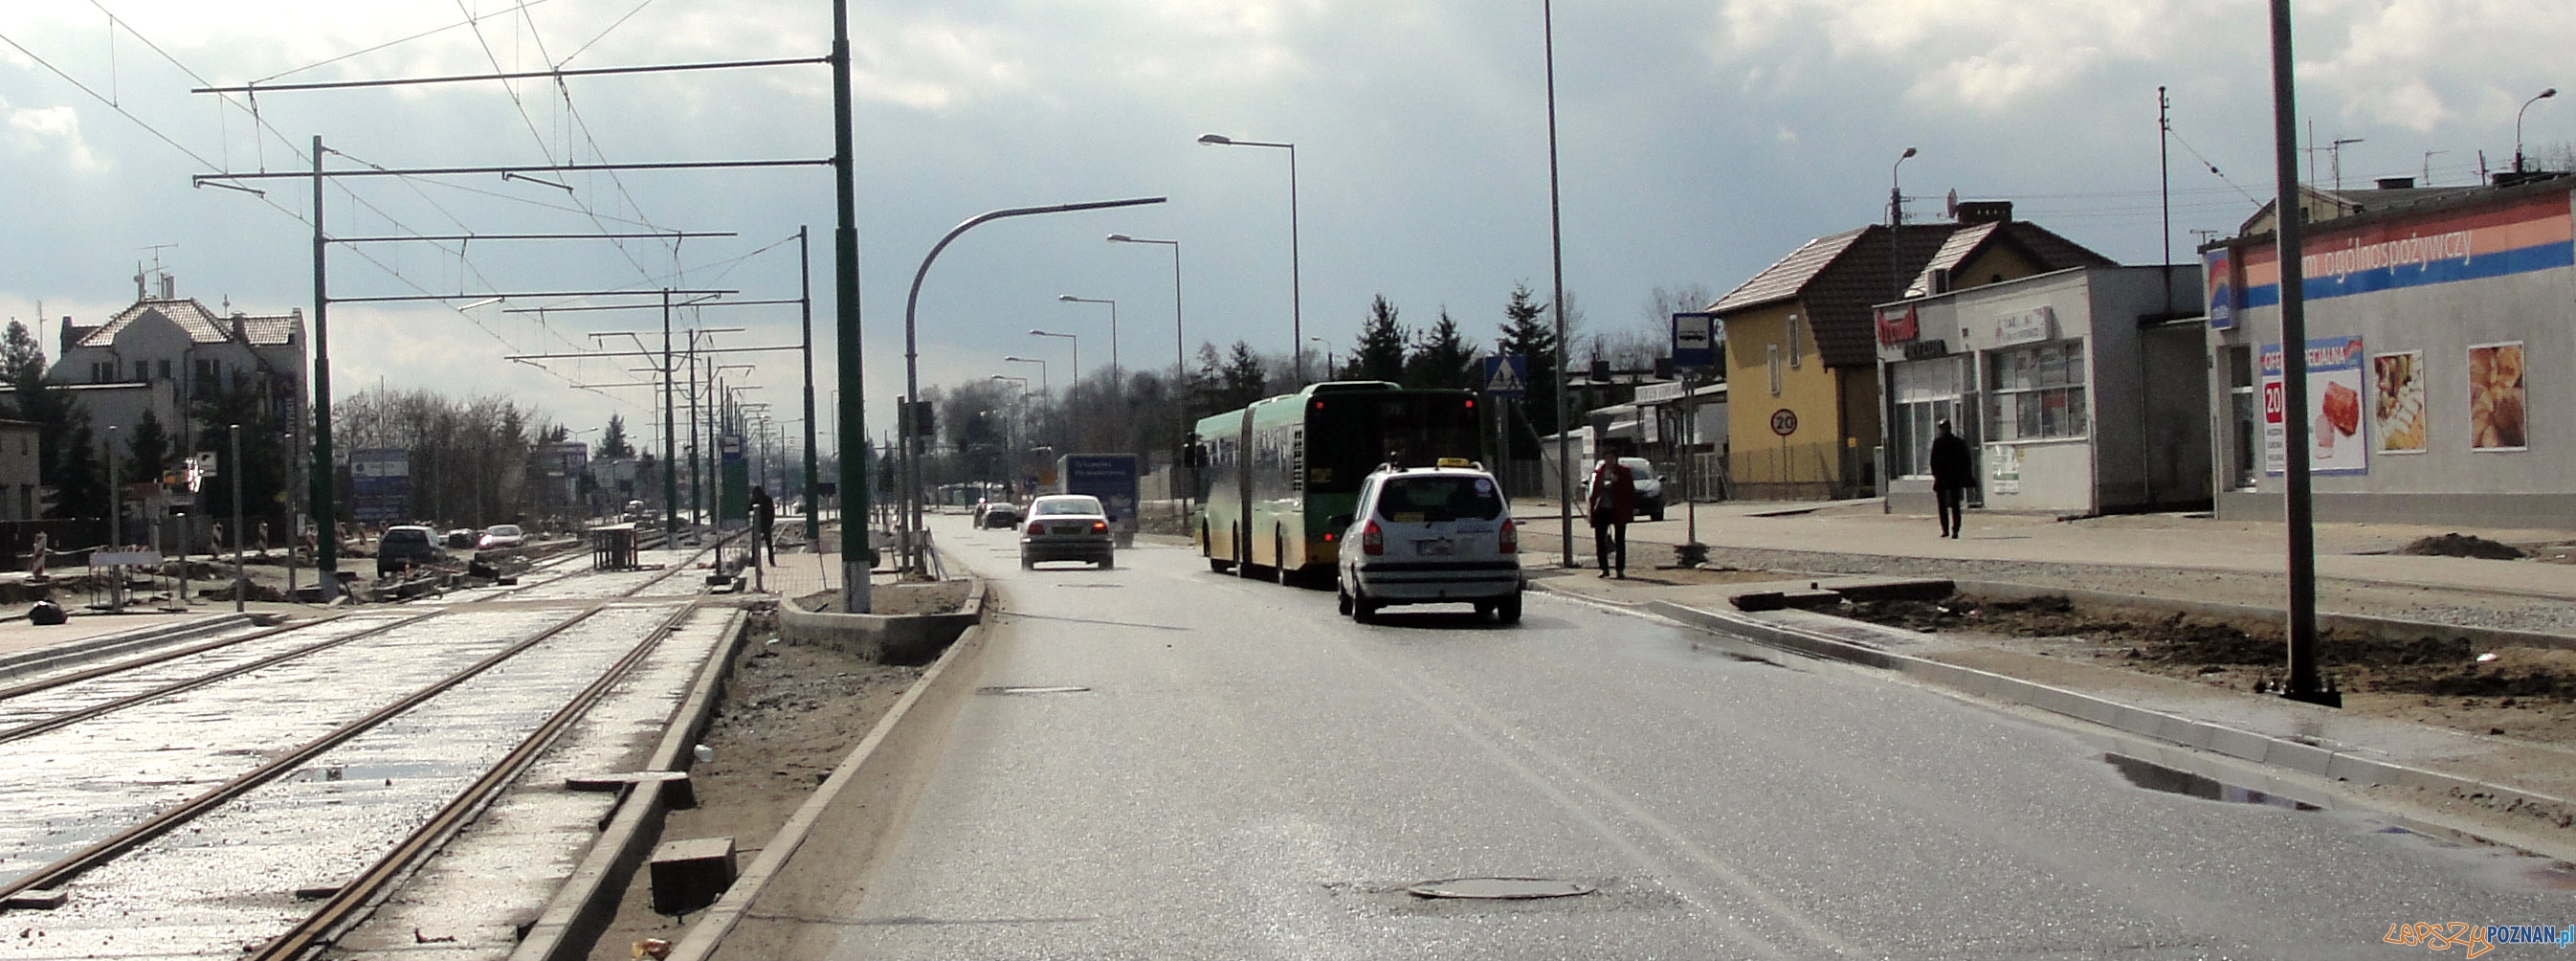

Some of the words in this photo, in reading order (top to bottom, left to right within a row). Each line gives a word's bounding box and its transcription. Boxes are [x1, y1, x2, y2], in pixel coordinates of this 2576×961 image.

[2325, 230, 2473, 284] ogólnospożywczy
[2266, 388, 2281, 413] 20
[1776, 415, 1794, 430] 20
